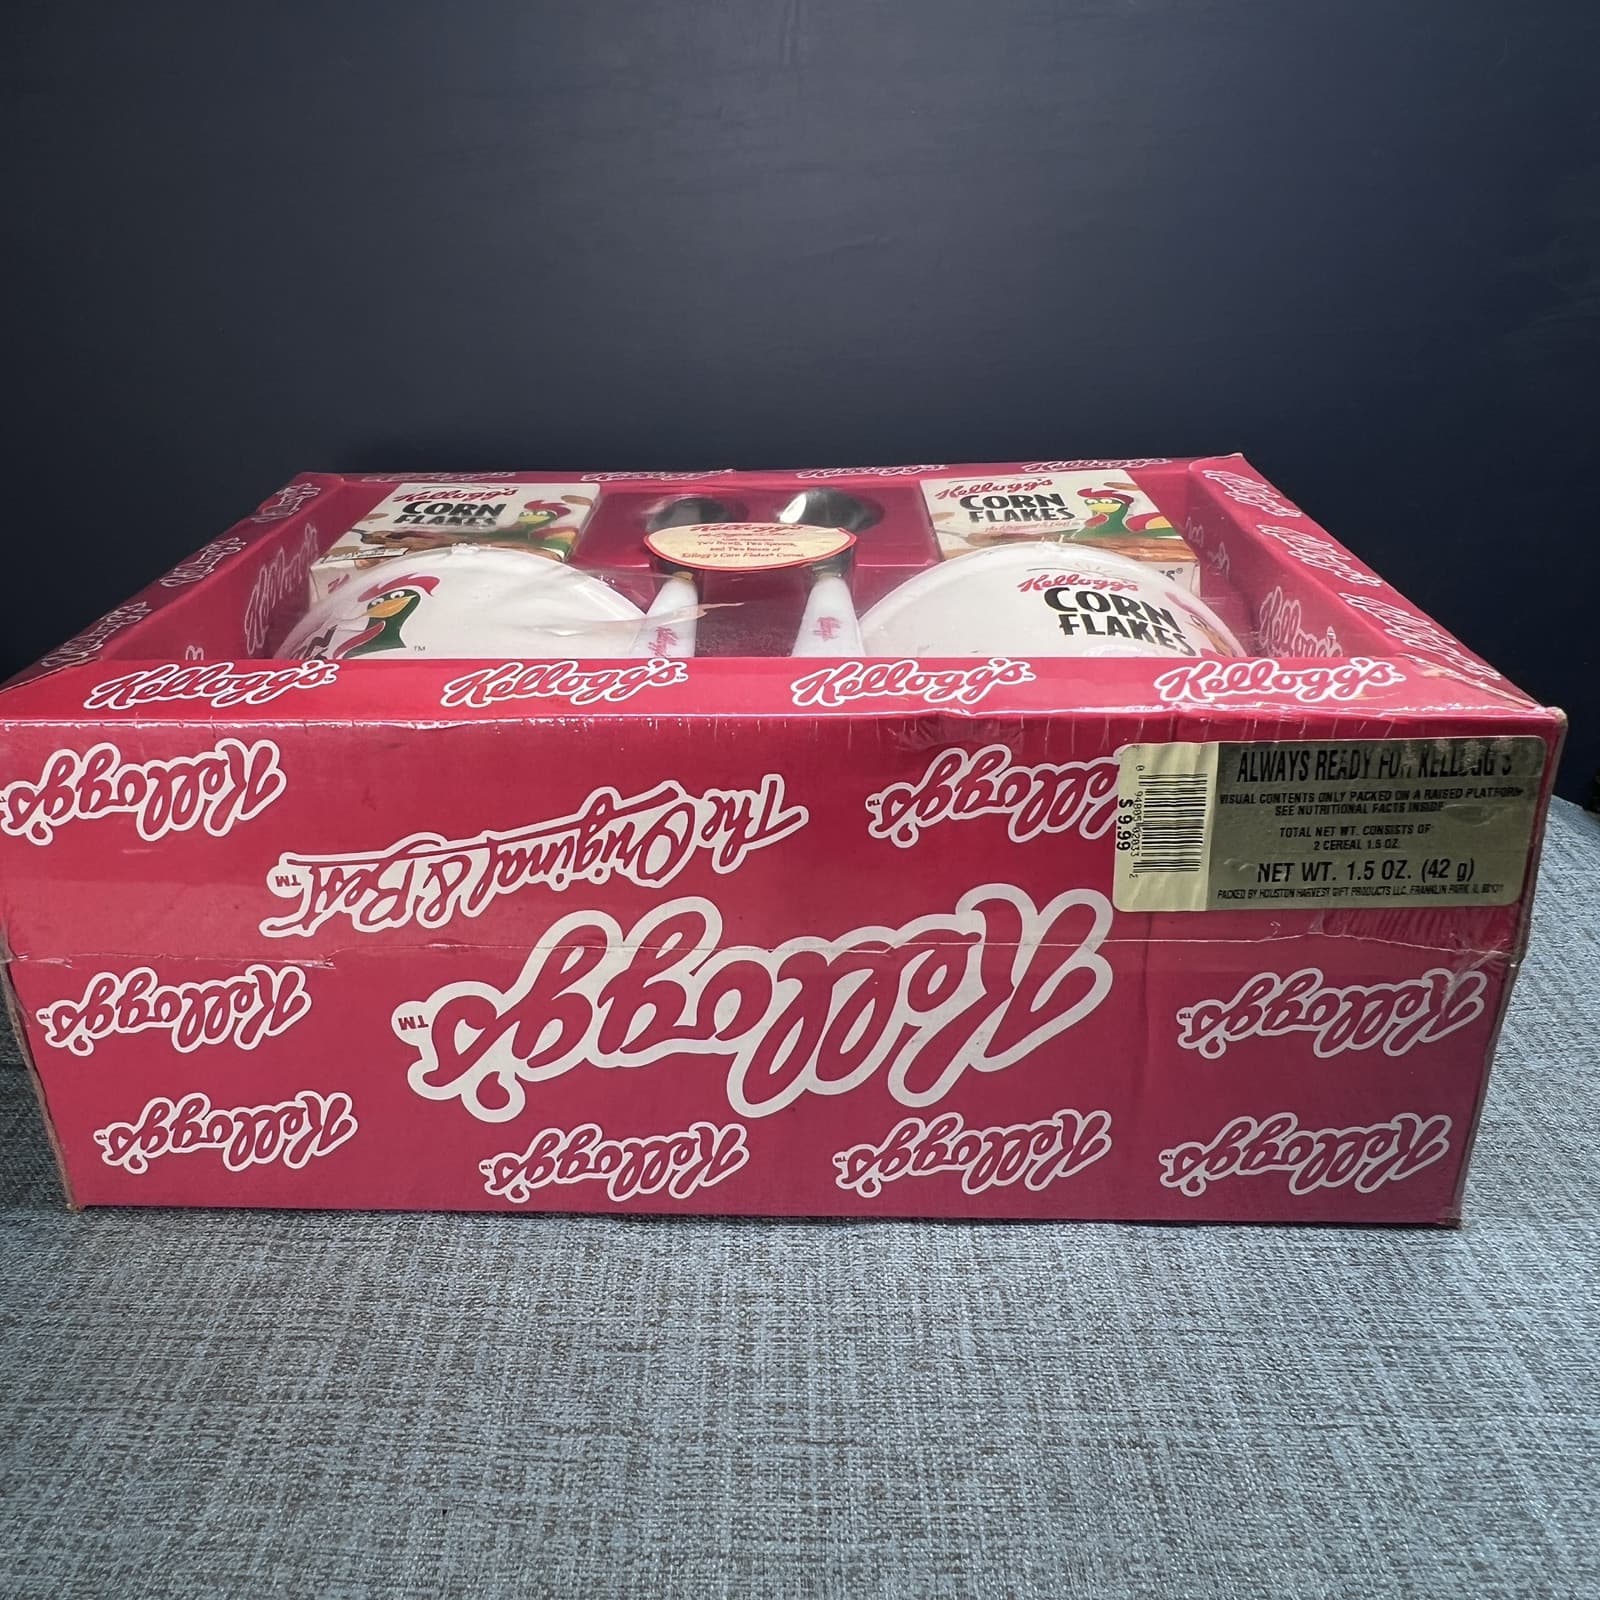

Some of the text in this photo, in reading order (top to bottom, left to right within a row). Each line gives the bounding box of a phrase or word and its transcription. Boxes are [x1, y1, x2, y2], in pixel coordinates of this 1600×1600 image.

[392, 488, 519, 502] Kellogg's
[402, 501, 507, 517] CORN
[935, 477, 1053, 500] Kellogg's
[959, 494, 1066, 510] CORN
[969, 507, 1076, 524] FLAKES
[1017, 573, 1139, 592] Kellogg's
[1044, 587, 1182, 634] CORN
[1058, 613, 1197, 657] FLAKES
[84, 659, 339, 710] Kellogg's
[440, 658, 688, 708] Kellogg's
[791, 657, 1036, 707] Kellogg's
[1154, 657, 1407, 702] Kellogg's
[1236, 750, 1311, 783] ALWAYS
[1314, 749, 1372, 781] READY
[1, 738, 287, 846] Kellogg's
[868, 744, 1120, 848] ellogg's
[1219, 793, 1257, 804] VISUAL
[1259, 792, 1315, 804] CONTENTS
[1318, 791, 1346, 803] ONLY
[1350, 790, 1392, 802] PACKED
[1395, 790, 1411, 801] ON
[1413, 789, 1421, 800] A
[1424, 788, 1463, 800] RAISED
[1275, 801, 1444, 816] SEE NUTRITIONAL FACTS INSIDE
[702, 774, 808, 874] The
[1116, 814, 1132, 851] 9.99
[1280, 826, 1312, 838] TOTAL
[1315, 825, 1337, 837] NET
[1339, 825, 1359, 837] WT.
[1362, 825, 1414, 836] CONSISTS
[1313, 841, 1320, 851] 2
[1323, 840, 1362, 851] CEREAL
[1367, 839, 1382, 850] 1.5
[470, 786, 697, 914] Original
[1257, 857, 1475, 883] NET WT. 1.5 OZ. (42 g)
[261, 858, 418, 935] Best
[418, 854, 472, 927] &
[1217, 888, 1246, 899] PACKED
[1259, 887, 1295, 899] HOUSTON
[1332, 887, 1349, 897] GIFT
[1351, 885, 1391, 897] PRODUCTS
[45, 964, 312, 1056] Kellogg's
[398, 883, 1113, 1123] Kellogg's TM
[1177, 967, 1487, 1059] Kellogg's
[102, 1091, 358, 1174] Kellogg's
[836, 1108, 1112, 1198] Kellogg's
[1160, 1112, 1451, 1197] Kellogg's
[485, 1121, 750, 1203] Kellogg's
